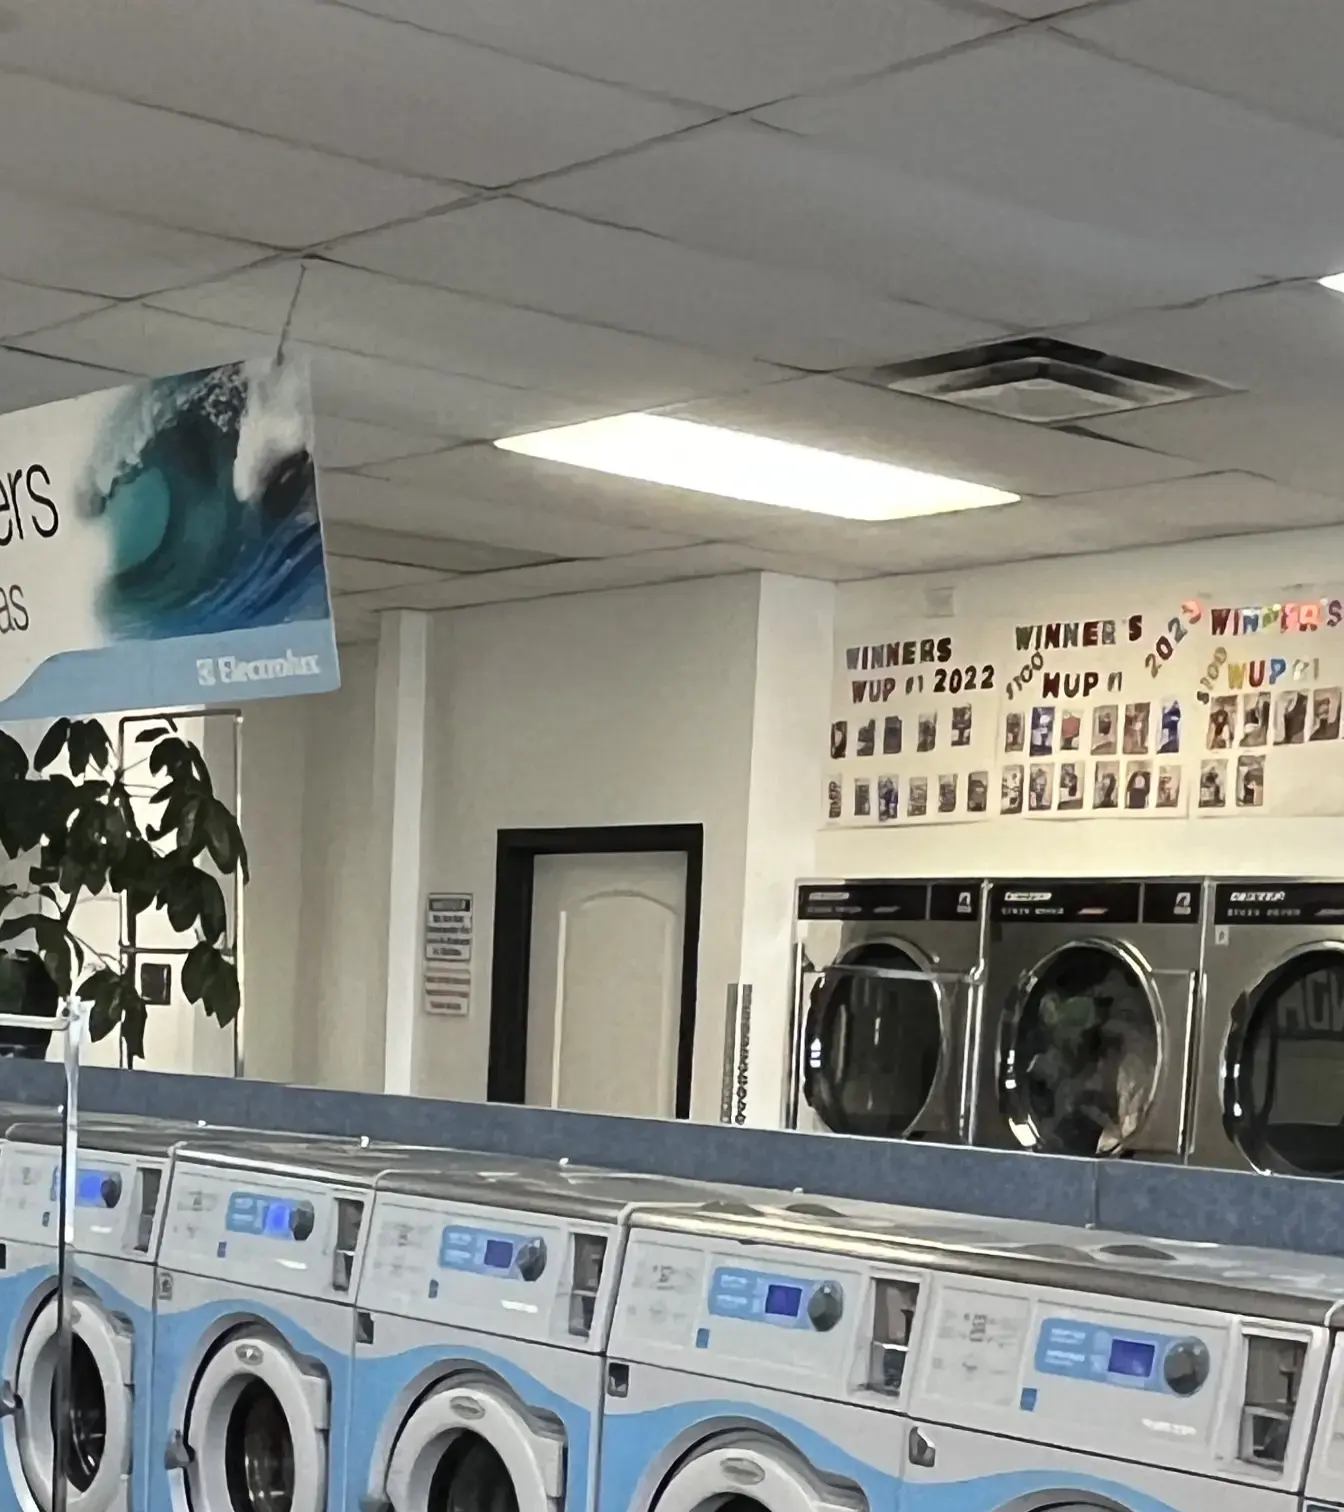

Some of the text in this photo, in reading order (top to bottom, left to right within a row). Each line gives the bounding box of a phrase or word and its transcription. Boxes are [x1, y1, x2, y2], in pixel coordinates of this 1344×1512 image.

[846, 637, 953, 671] WINNERS
[851, 677, 897, 704] WUP
[932, 664, 995, 694] 2022
[1227, 657, 1287, 690] WUP
